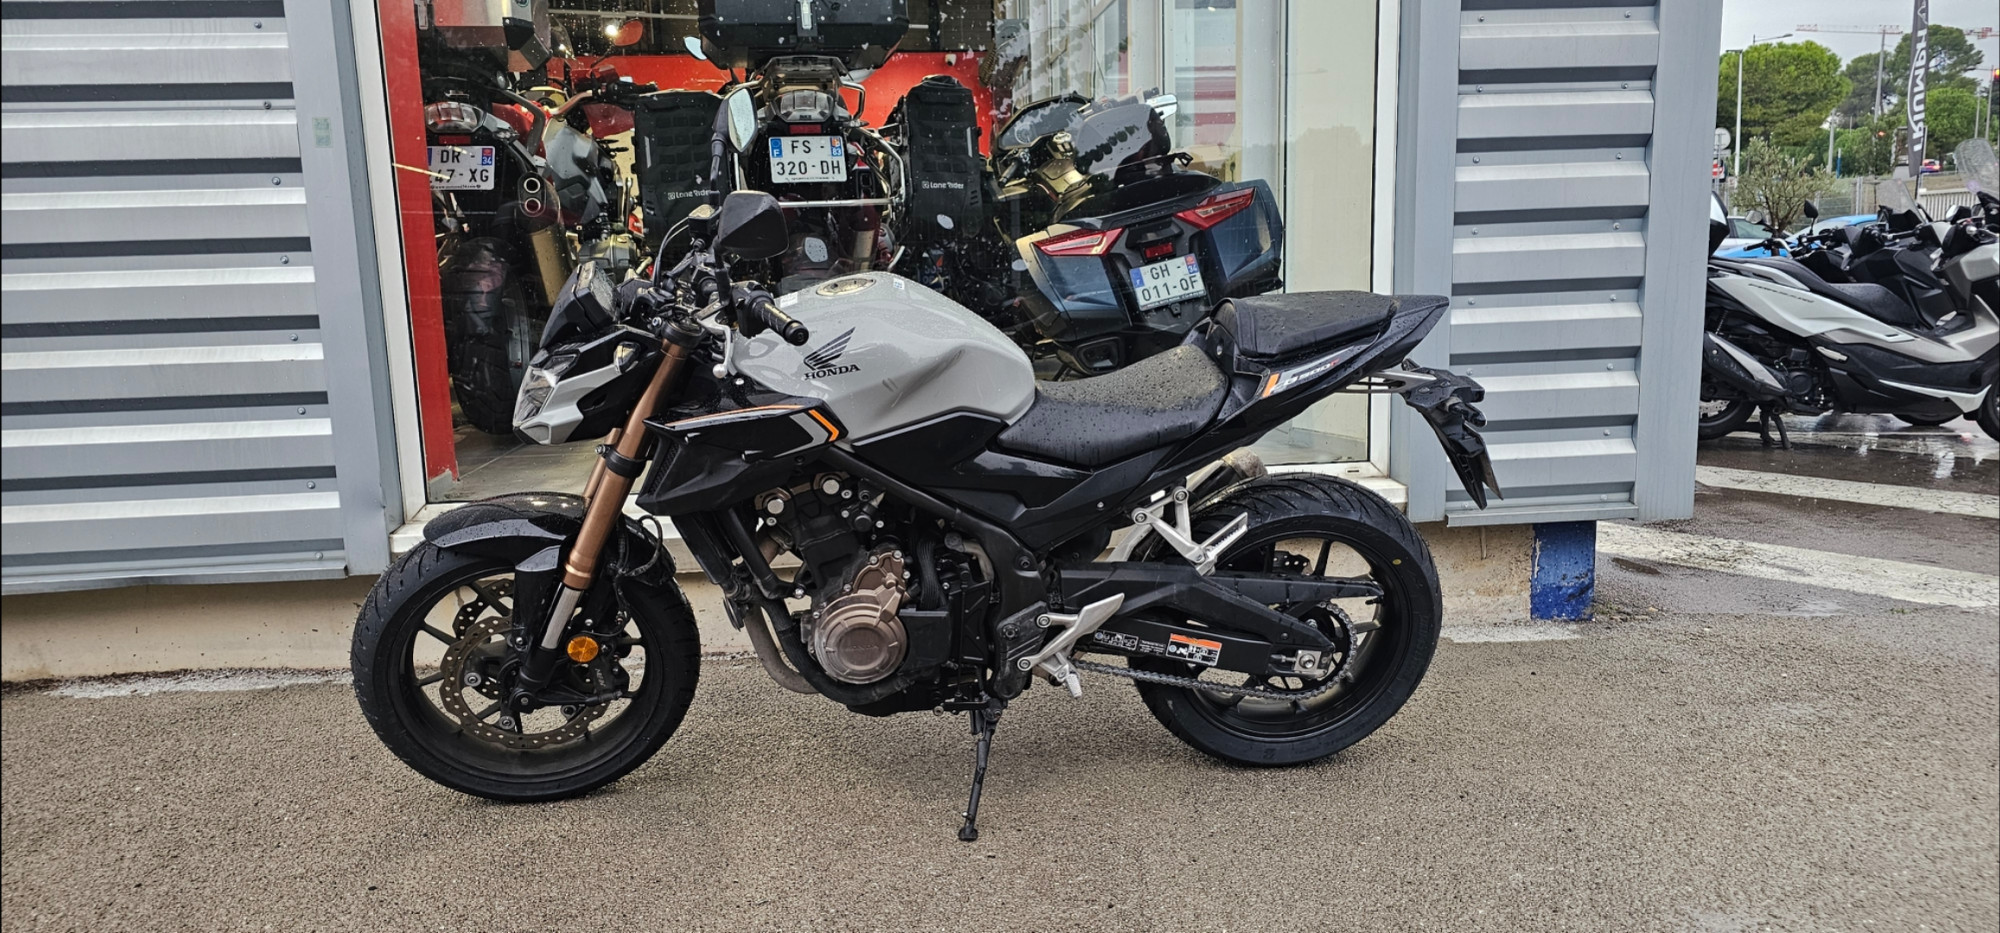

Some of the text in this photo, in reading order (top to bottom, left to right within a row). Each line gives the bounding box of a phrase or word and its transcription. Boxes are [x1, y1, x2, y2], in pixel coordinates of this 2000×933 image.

[482, 156, 492, 165] 34
[776, 160, 841, 176] 320-DH
[429, 168, 489, 184] 47-XG
[804, 363, 861, 381] HONDA
